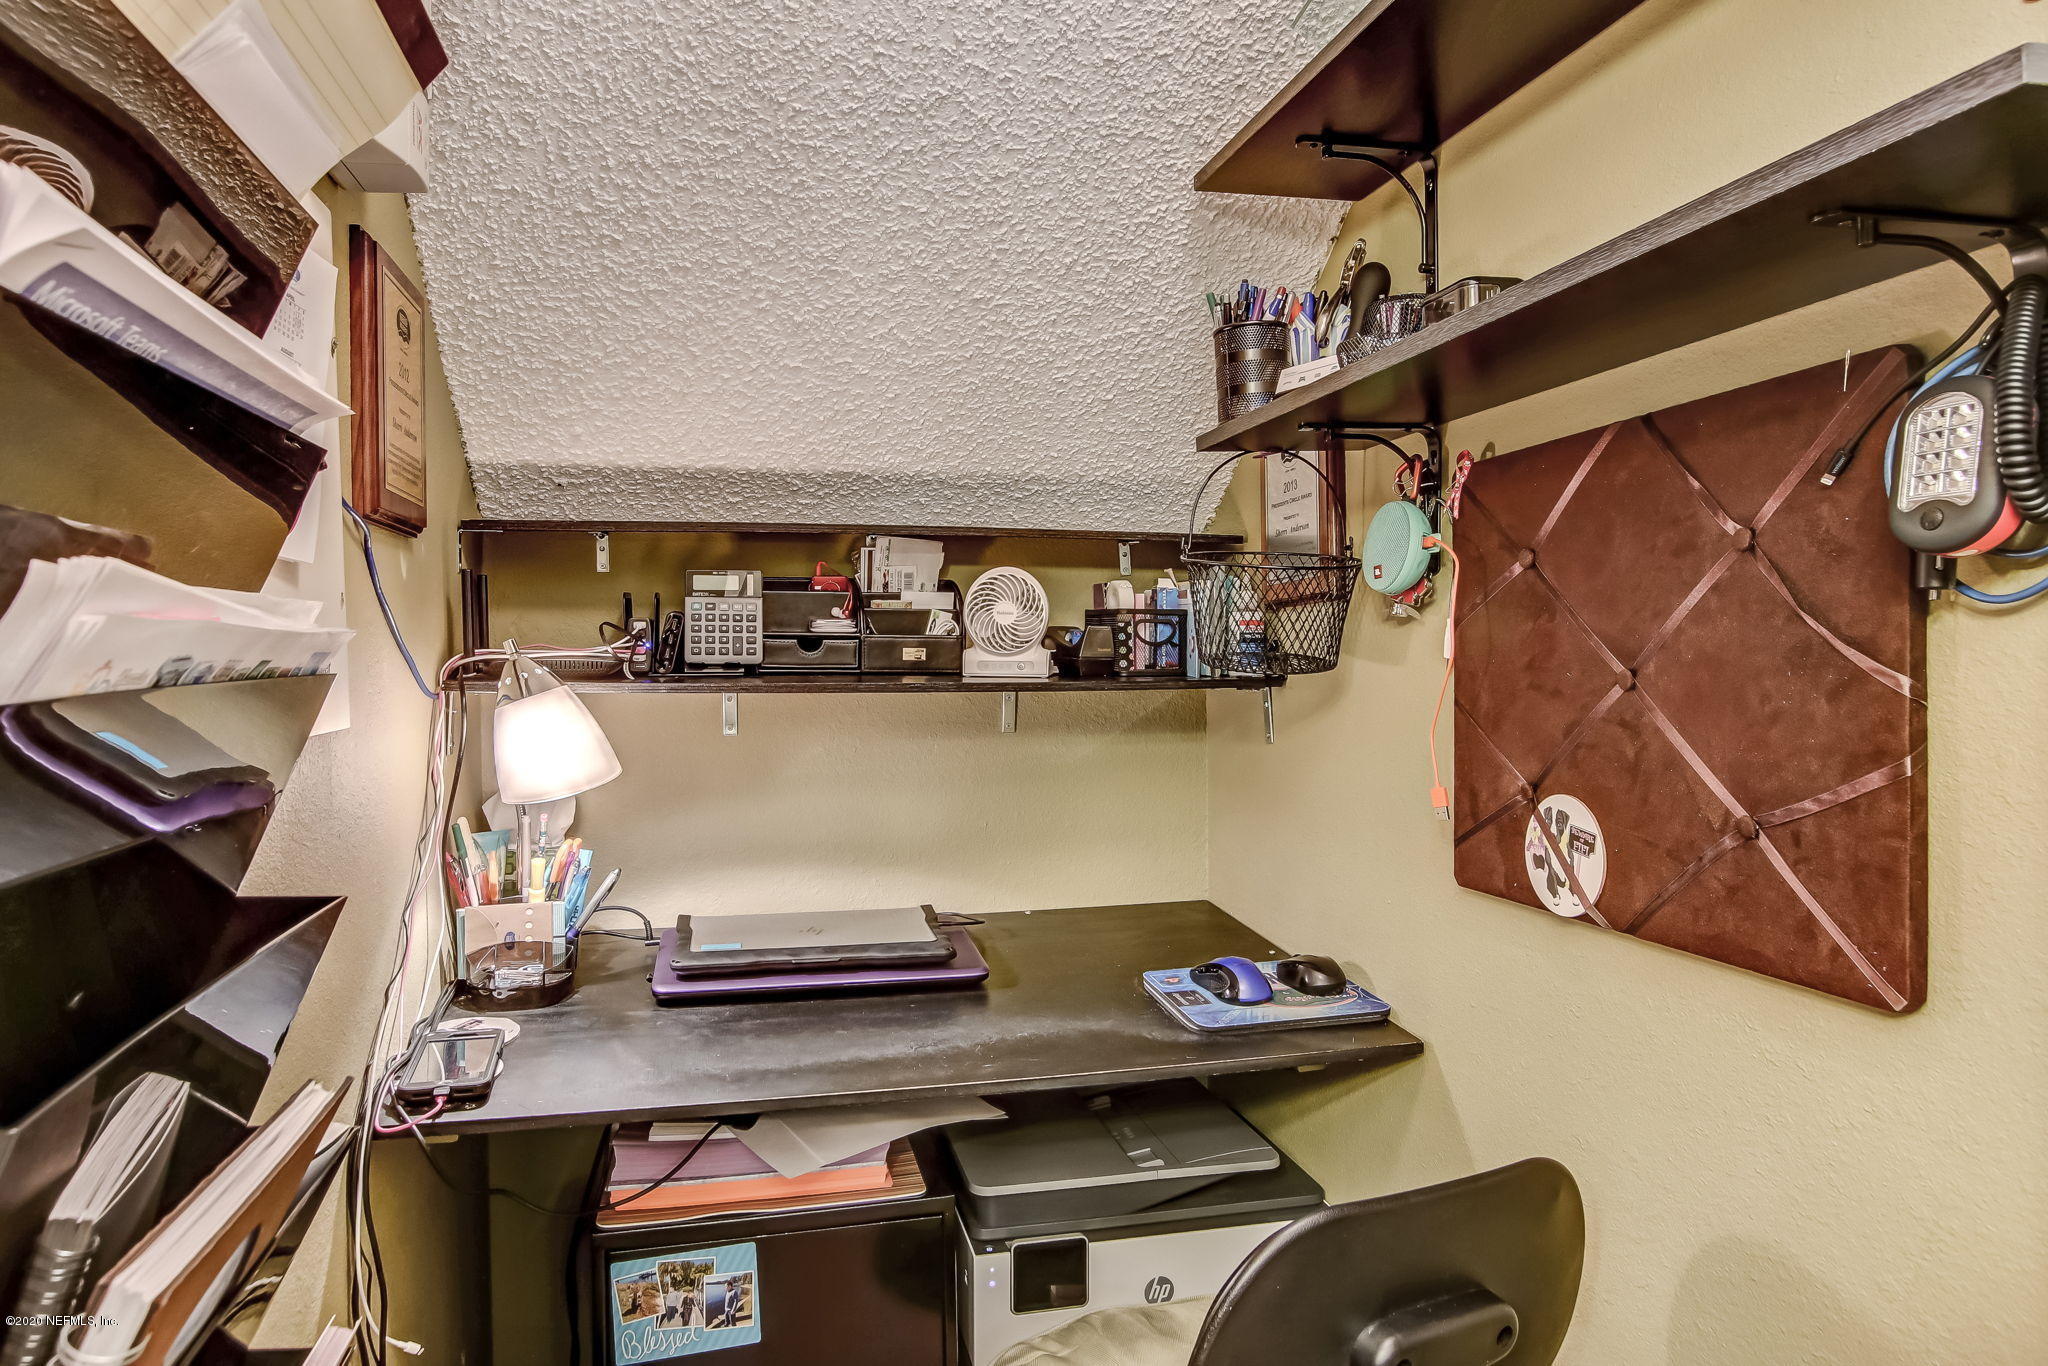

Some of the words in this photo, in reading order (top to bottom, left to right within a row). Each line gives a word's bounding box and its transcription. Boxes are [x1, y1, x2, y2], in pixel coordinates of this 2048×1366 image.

[117, 325, 168, 363] Teams
[1283, 479, 1298, 494] 2013
[1147, 1276, 1172, 1303] hp
[621, 1325, 700, 1360] Blessed
